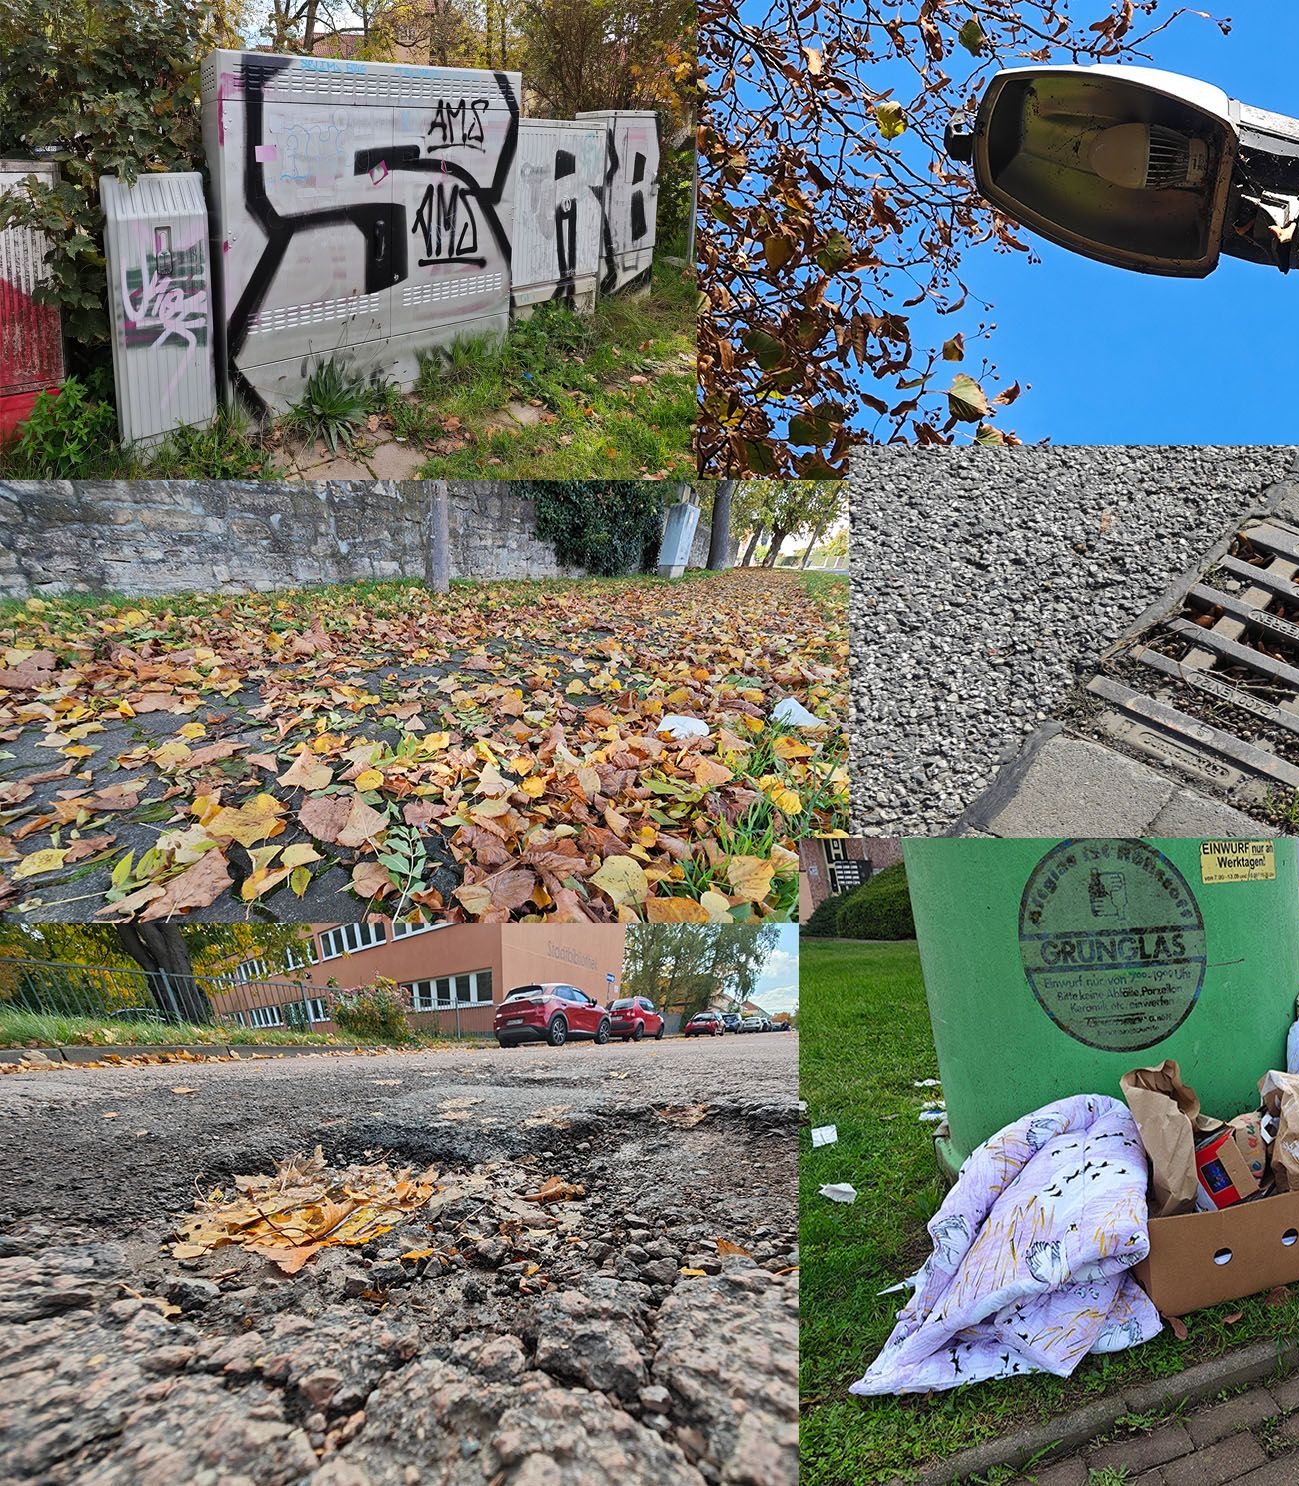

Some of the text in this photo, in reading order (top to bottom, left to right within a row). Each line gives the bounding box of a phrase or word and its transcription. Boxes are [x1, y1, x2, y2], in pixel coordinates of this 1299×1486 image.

[428, 98, 489, 150] AMS
[411, 184, 480, 260] AMS
[1202, 842, 1249, 855] EINWURF
[1251, 845, 1264, 854] nur
